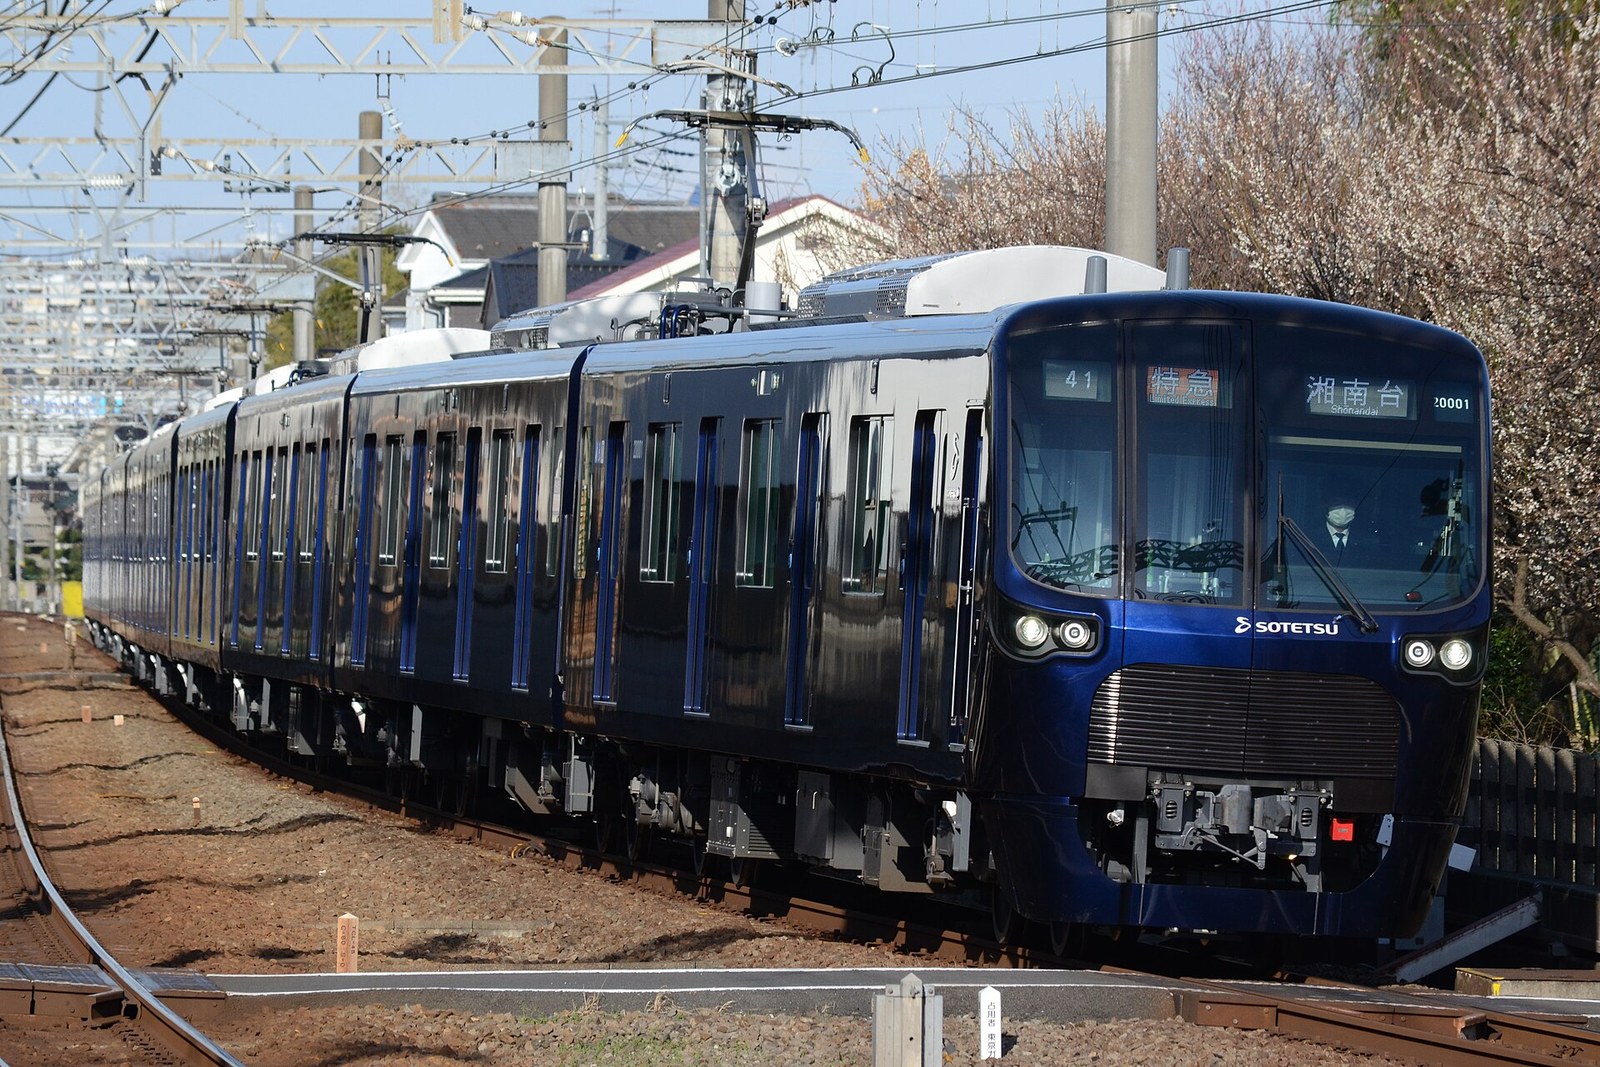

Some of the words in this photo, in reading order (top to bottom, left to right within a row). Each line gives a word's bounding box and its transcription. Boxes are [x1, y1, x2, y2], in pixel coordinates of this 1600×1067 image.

[1065, 369, 1092, 389] 41
[1151, 366, 1213, 396] 特急
[1149, 394, 1179, 404] Limited
[1182, 396, 1214, 406] Express
[1307, 375, 1404, 408] 湘南台
[1433, 397, 1469, 410] 20001
[1255, 621, 1339, 635] SOTETSU
